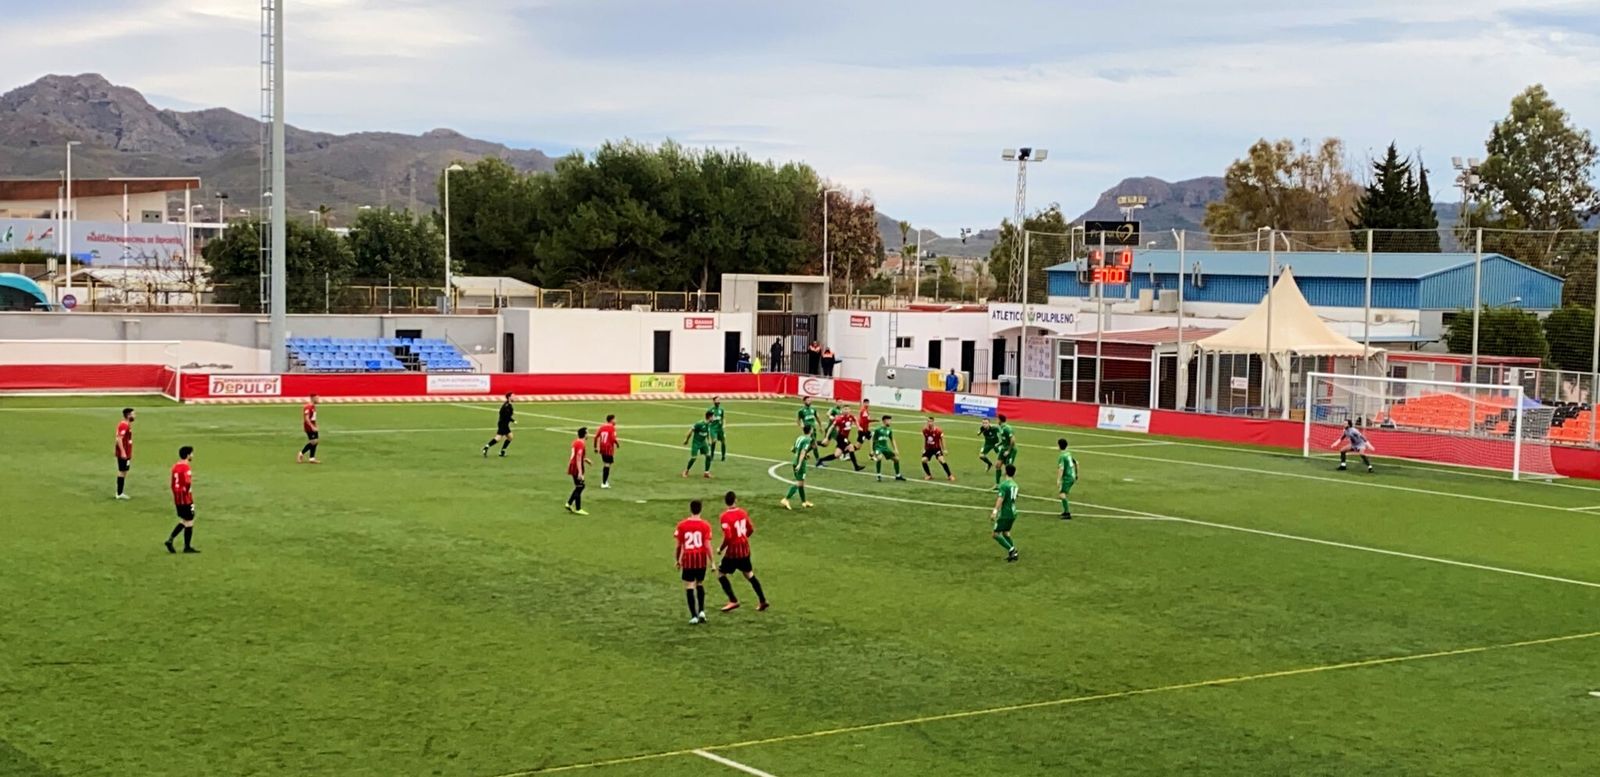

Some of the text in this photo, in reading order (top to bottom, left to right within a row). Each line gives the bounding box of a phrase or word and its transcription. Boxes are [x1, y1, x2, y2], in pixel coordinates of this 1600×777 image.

[1121, 251, 1131, 265] 0
[686, 318, 693, 328] B
[734, 519, 747, 537] 14
[684, 531, 702, 549] 20
